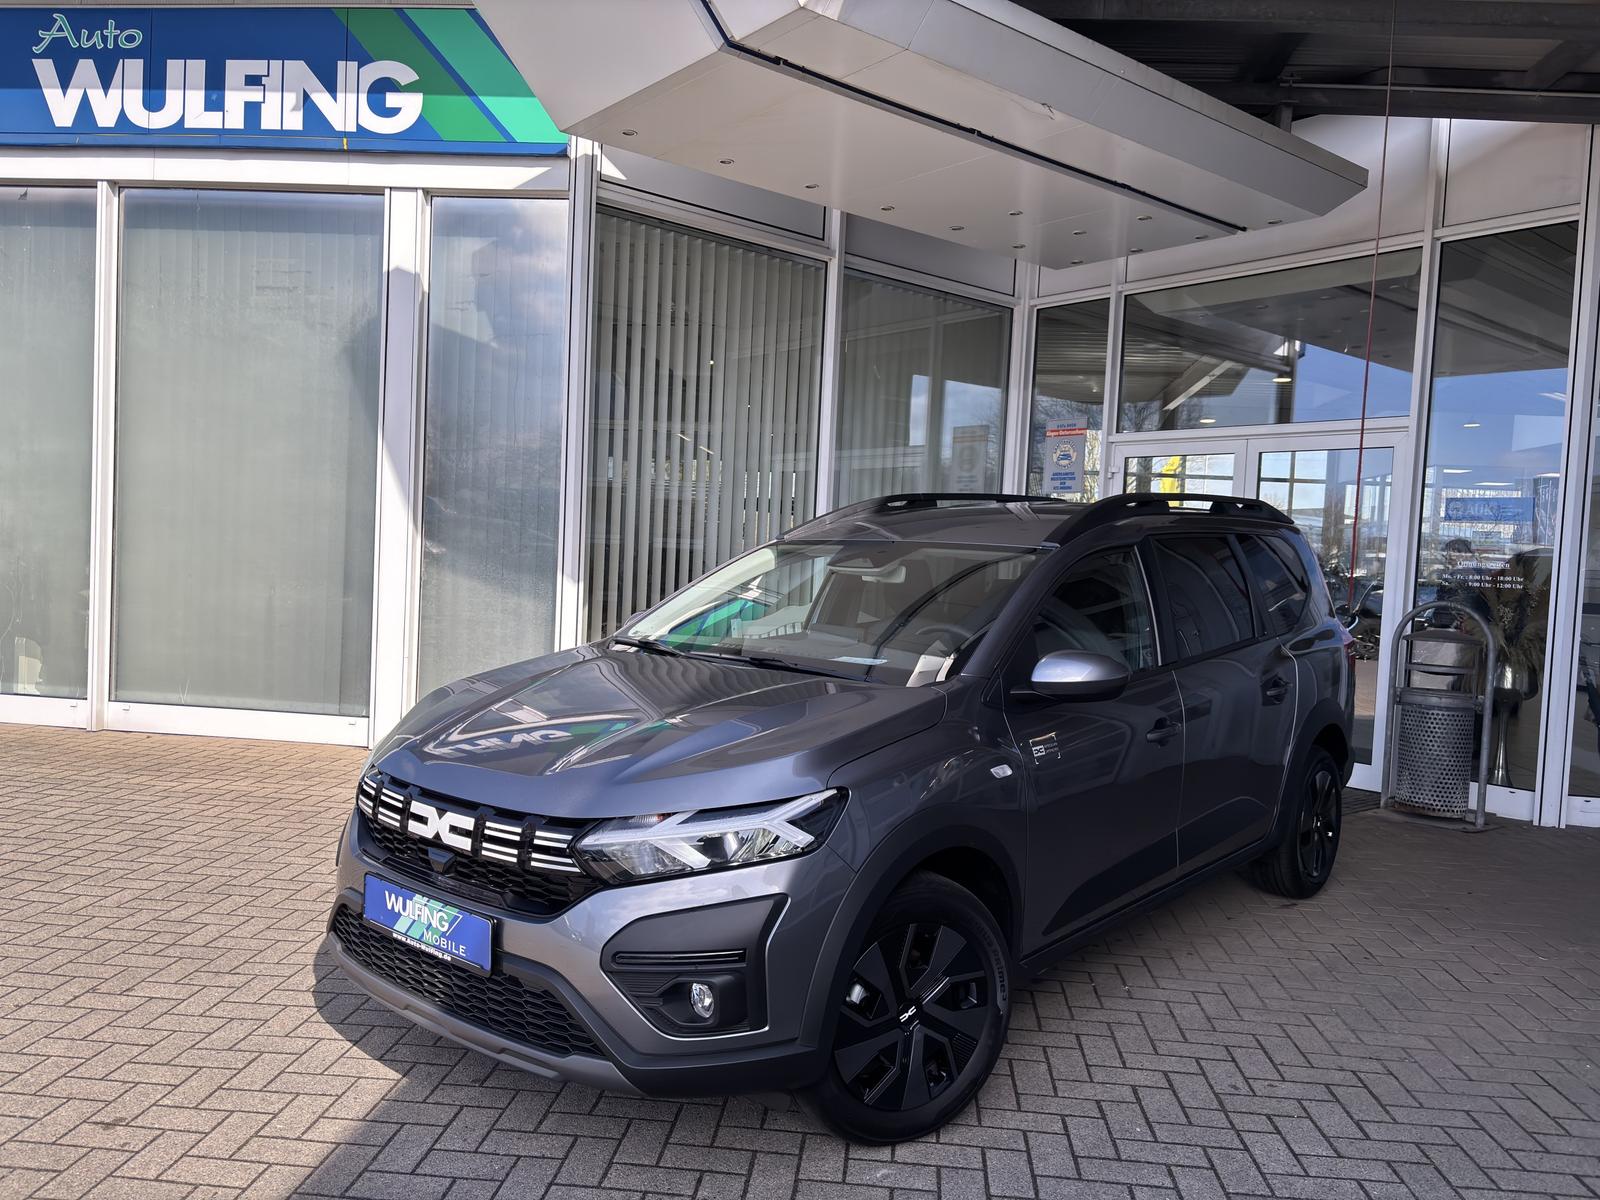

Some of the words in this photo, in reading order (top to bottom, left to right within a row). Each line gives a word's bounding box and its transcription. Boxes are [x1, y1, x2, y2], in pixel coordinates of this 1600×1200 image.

[32, 13, 142, 53] Auto
[31, 58, 424, 135] WULFING
[385, 890, 449, 932] WULFING
[423, 929, 467, 967] MOBILE
